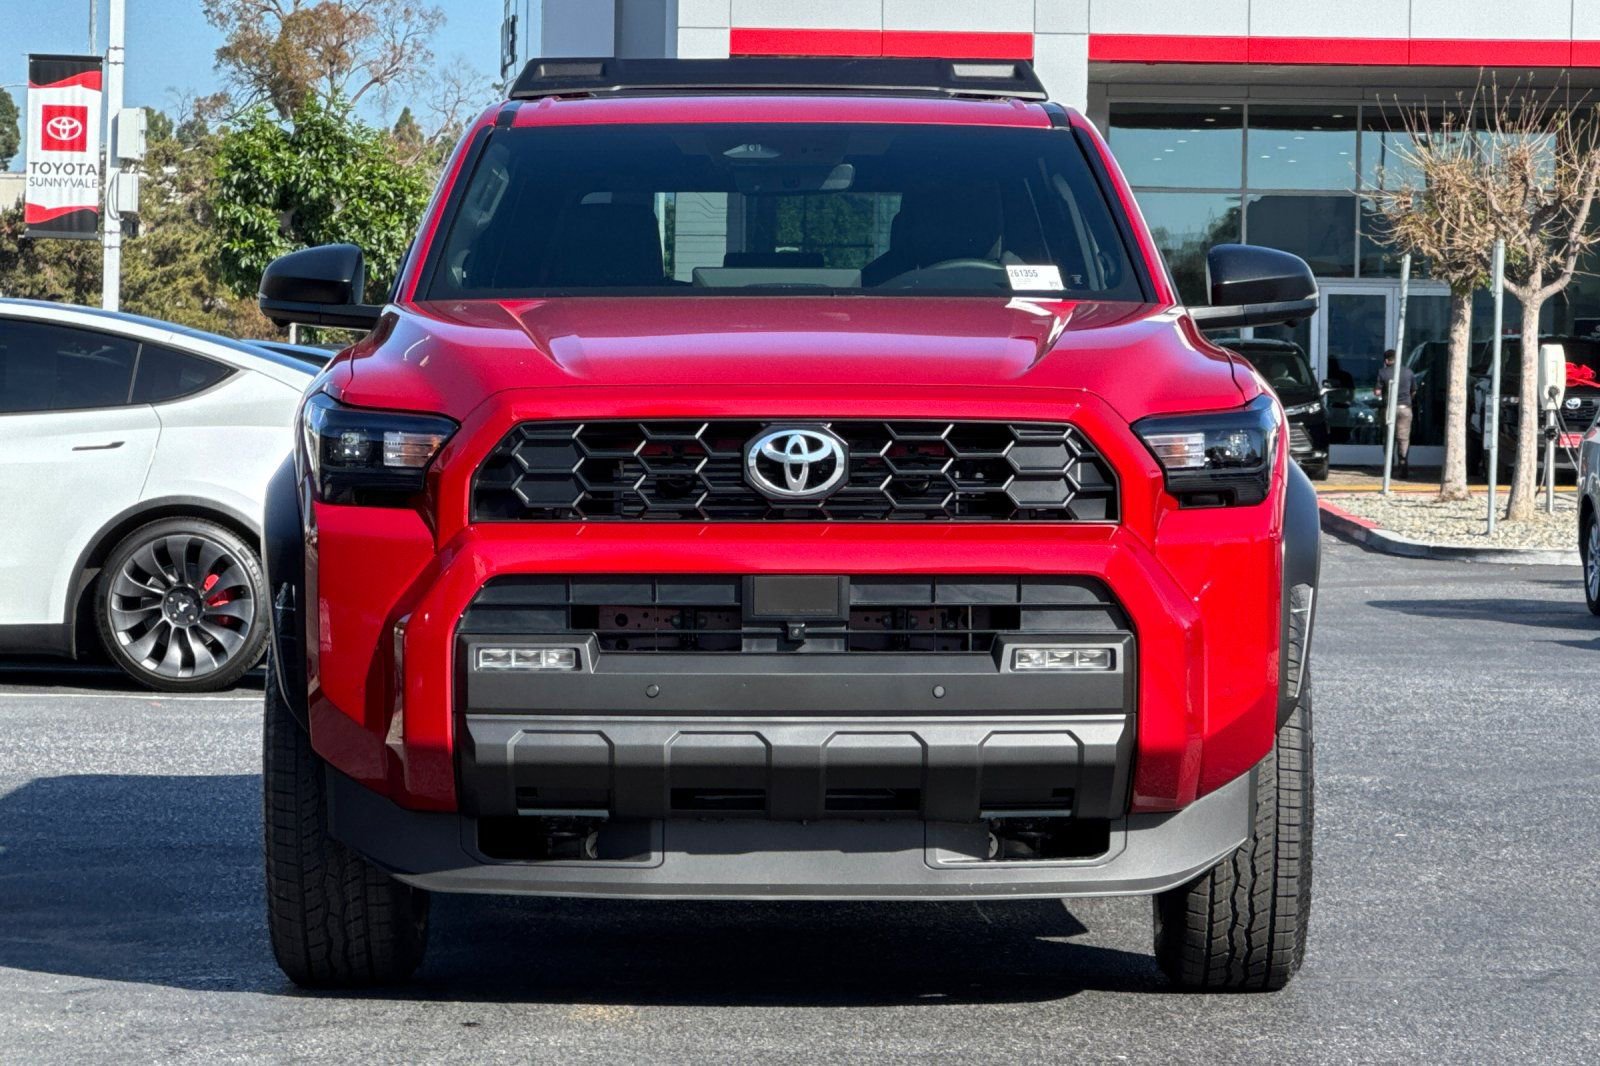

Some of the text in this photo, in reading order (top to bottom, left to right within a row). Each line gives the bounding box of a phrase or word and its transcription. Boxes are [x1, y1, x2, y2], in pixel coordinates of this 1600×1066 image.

[29, 162, 97, 175] TOYOTA
[29, 177, 97, 188] SUNNYVALE
[1009, 269, 1038, 278] 261355
